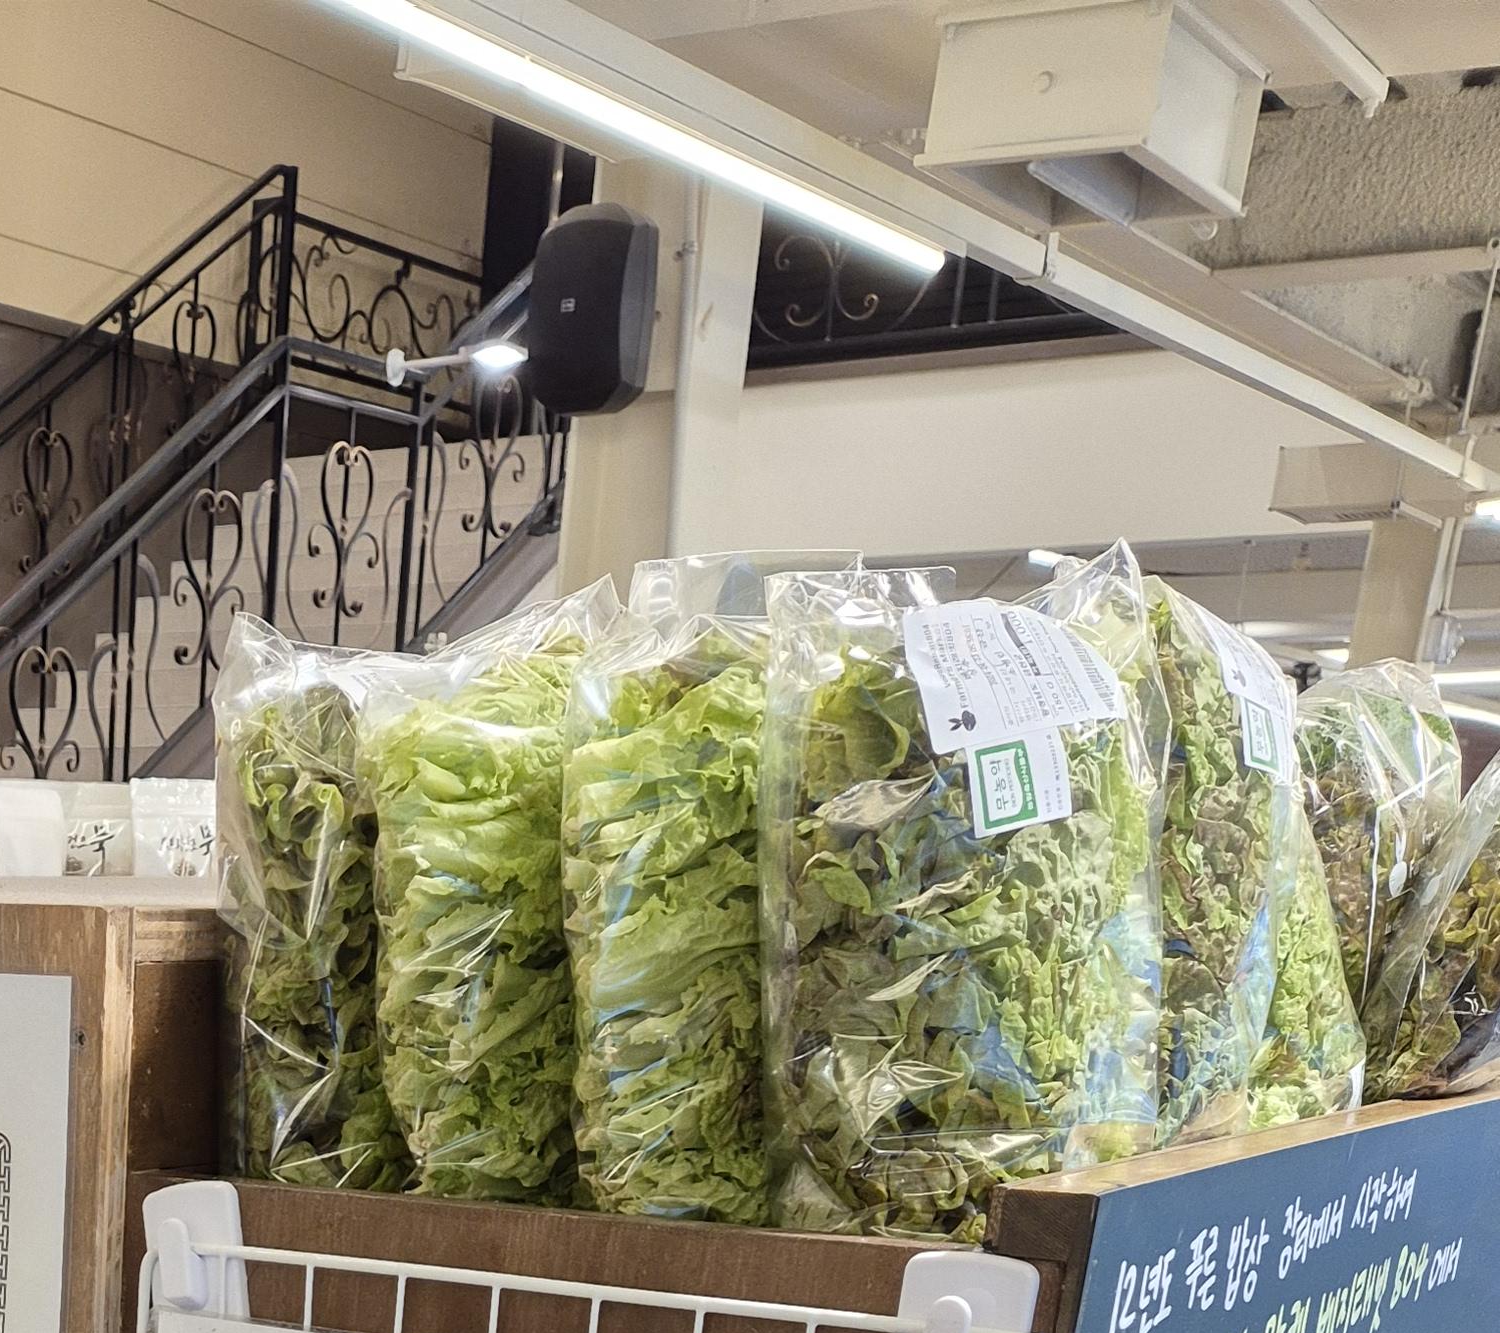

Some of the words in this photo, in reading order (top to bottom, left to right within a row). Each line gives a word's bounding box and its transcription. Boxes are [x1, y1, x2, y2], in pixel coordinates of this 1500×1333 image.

[989, 759, 1010, 811] 무농약
[1185, 1227, 1219, 1311] 푸른
[1224, 1216, 1271, 1311] 밥상
[1276, 1195, 1347, 1280] 장터에서
[1350, 1166, 1418, 1233] 시작하여
